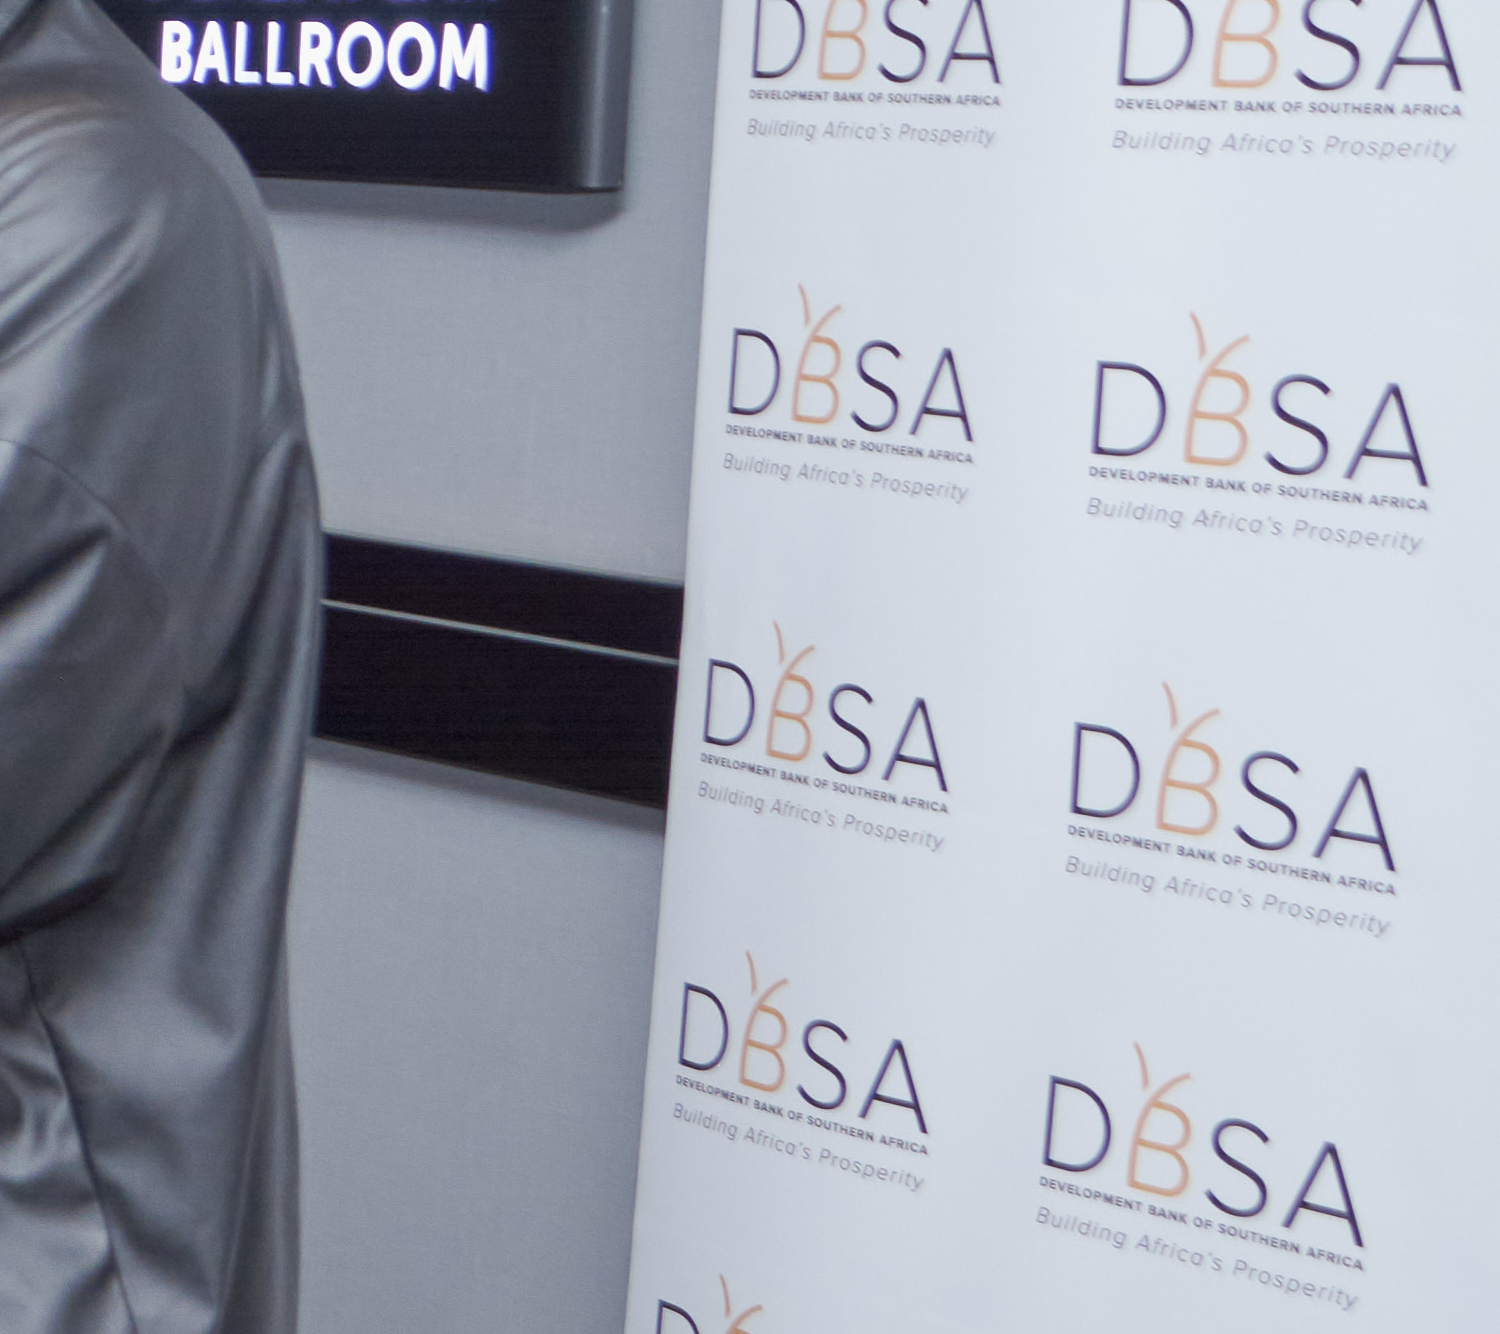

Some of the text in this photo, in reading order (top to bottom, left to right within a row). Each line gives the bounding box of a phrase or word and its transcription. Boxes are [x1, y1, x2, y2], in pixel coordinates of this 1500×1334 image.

[159, 19, 491, 92] BALLROOM
[748, 88, 1002, 107] DEVELOPMENT BANK OF SOUTHERN AFRICA
[746, 117, 997, 149] Building Africa's Prosperity
[1111, 129, 1457, 164] Building Africa's Prosperity
[1114, 97, 1463, 118] DEVELOPMENT BANK OF SOUTHERN AFRICA
[727, 282, 974, 443] DBSA
[1090, 310, 1429, 488] DBSA
[1085, 496, 1424, 556] Building Africa's Prosperity
[1088, 465, 1430, 513] DEVELOPMENT BANK OF SOUTHERN AFRICA
[701, 619, 949, 793] DBSA
[1069, 681, 1397, 873] DBSA
[1064, 854, 1392, 939] Building Africa's Prosperity
[1067, 824, 1397, 897] DEVELOPMENT BANK OF SOUTHERN AFRICA
[677, 950, 929, 1135] DBSA
[672, 1101, 925, 1193] Building Africa's Prosperity
[675, 1074, 929, 1156] DEVELOPMENT BANK OF SOUTHERN AFRICA
[1041, 1041, 1365, 1249] DBSA
[1035, 1205, 1360, 1312] Building Africa's Prosperity
[1039, 1175, 1365, 1273] DEVELOPMENT BANK OF SOUTHERN AFRICA
